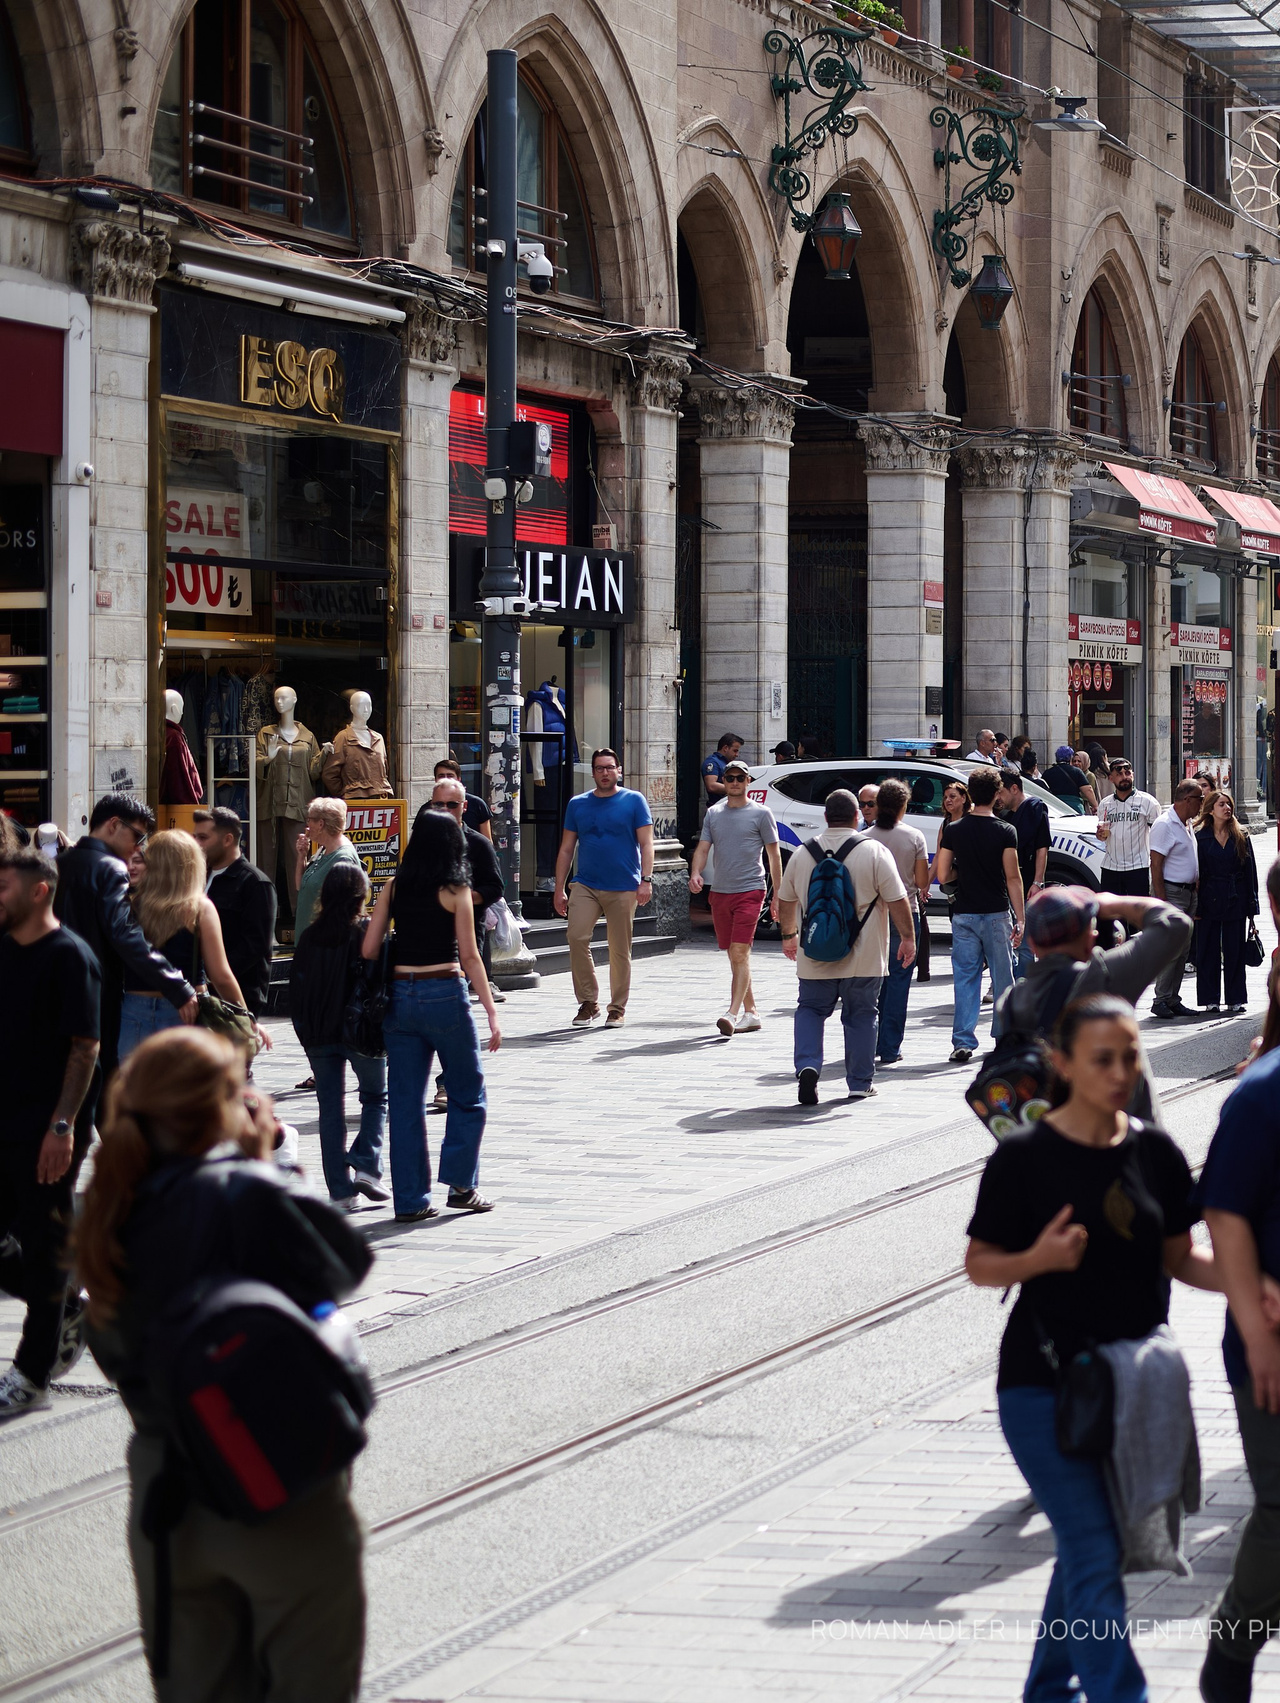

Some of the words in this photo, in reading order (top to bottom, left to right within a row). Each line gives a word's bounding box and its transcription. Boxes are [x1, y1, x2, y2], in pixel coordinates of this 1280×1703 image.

[239, 334, 346, 424] ESQ
[166, 500, 241, 538] SALE
[1140, 512, 1157, 529] PİKNİK
[1158, 517, 1172, 533] KÖFTE
[1080, 621, 1106, 635] SARAYBOSNA
[1079, 642, 1104, 659] PİKNİK
[1106, 645, 1128, 660] KÖFTE
[1179, 647, 1200, 663] PİKNİK
[1201, 650, 1220, 665] KÖFTE
[749, 791, 764, 802] 112
[345, 808, 395, 830] UTLET
[1106, 812, 1126, 823] POWER
[1126, 811, 1140, 822] PLAY
